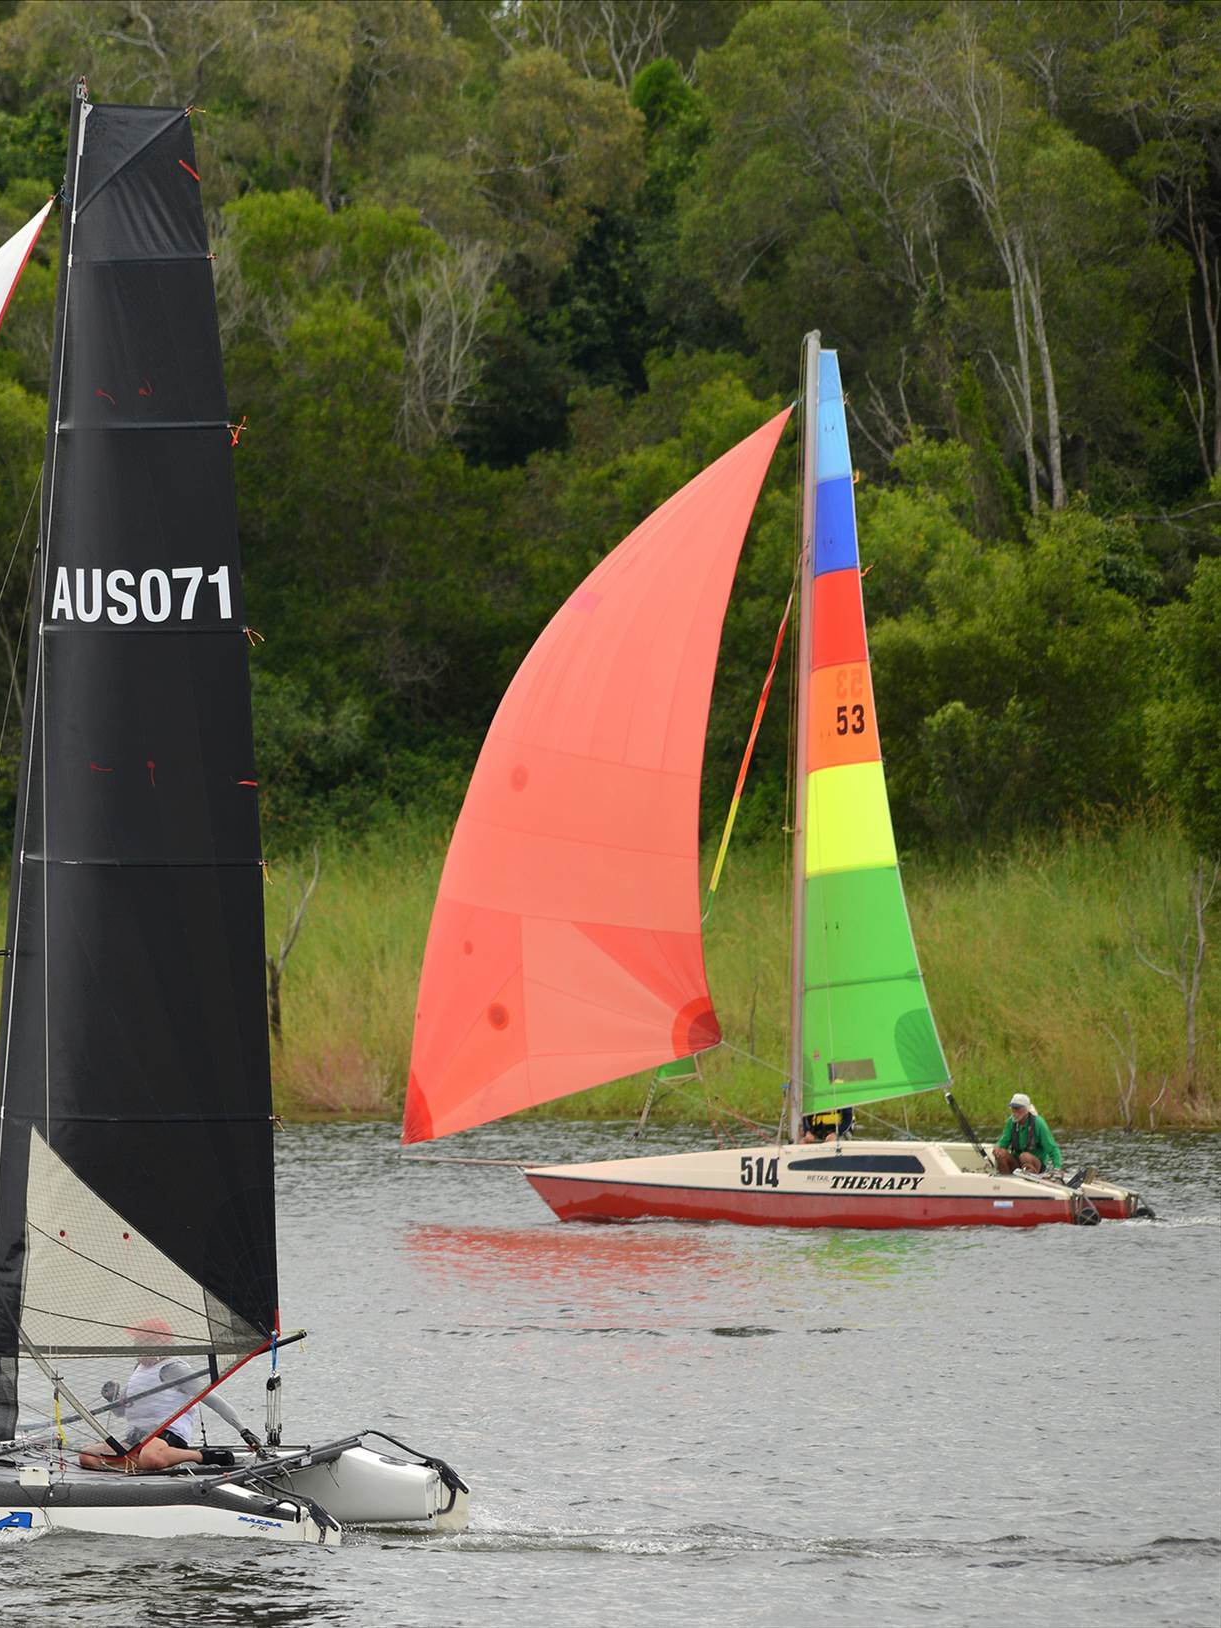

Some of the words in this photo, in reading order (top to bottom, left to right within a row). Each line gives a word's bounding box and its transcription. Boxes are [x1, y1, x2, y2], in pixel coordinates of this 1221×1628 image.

[51, 565, 233, 625] AUS071
[837, 704, 865, 735] 53
[741, 1156, 779, 1187] 514
[830, 1176, 923, 1190] THERAPY
